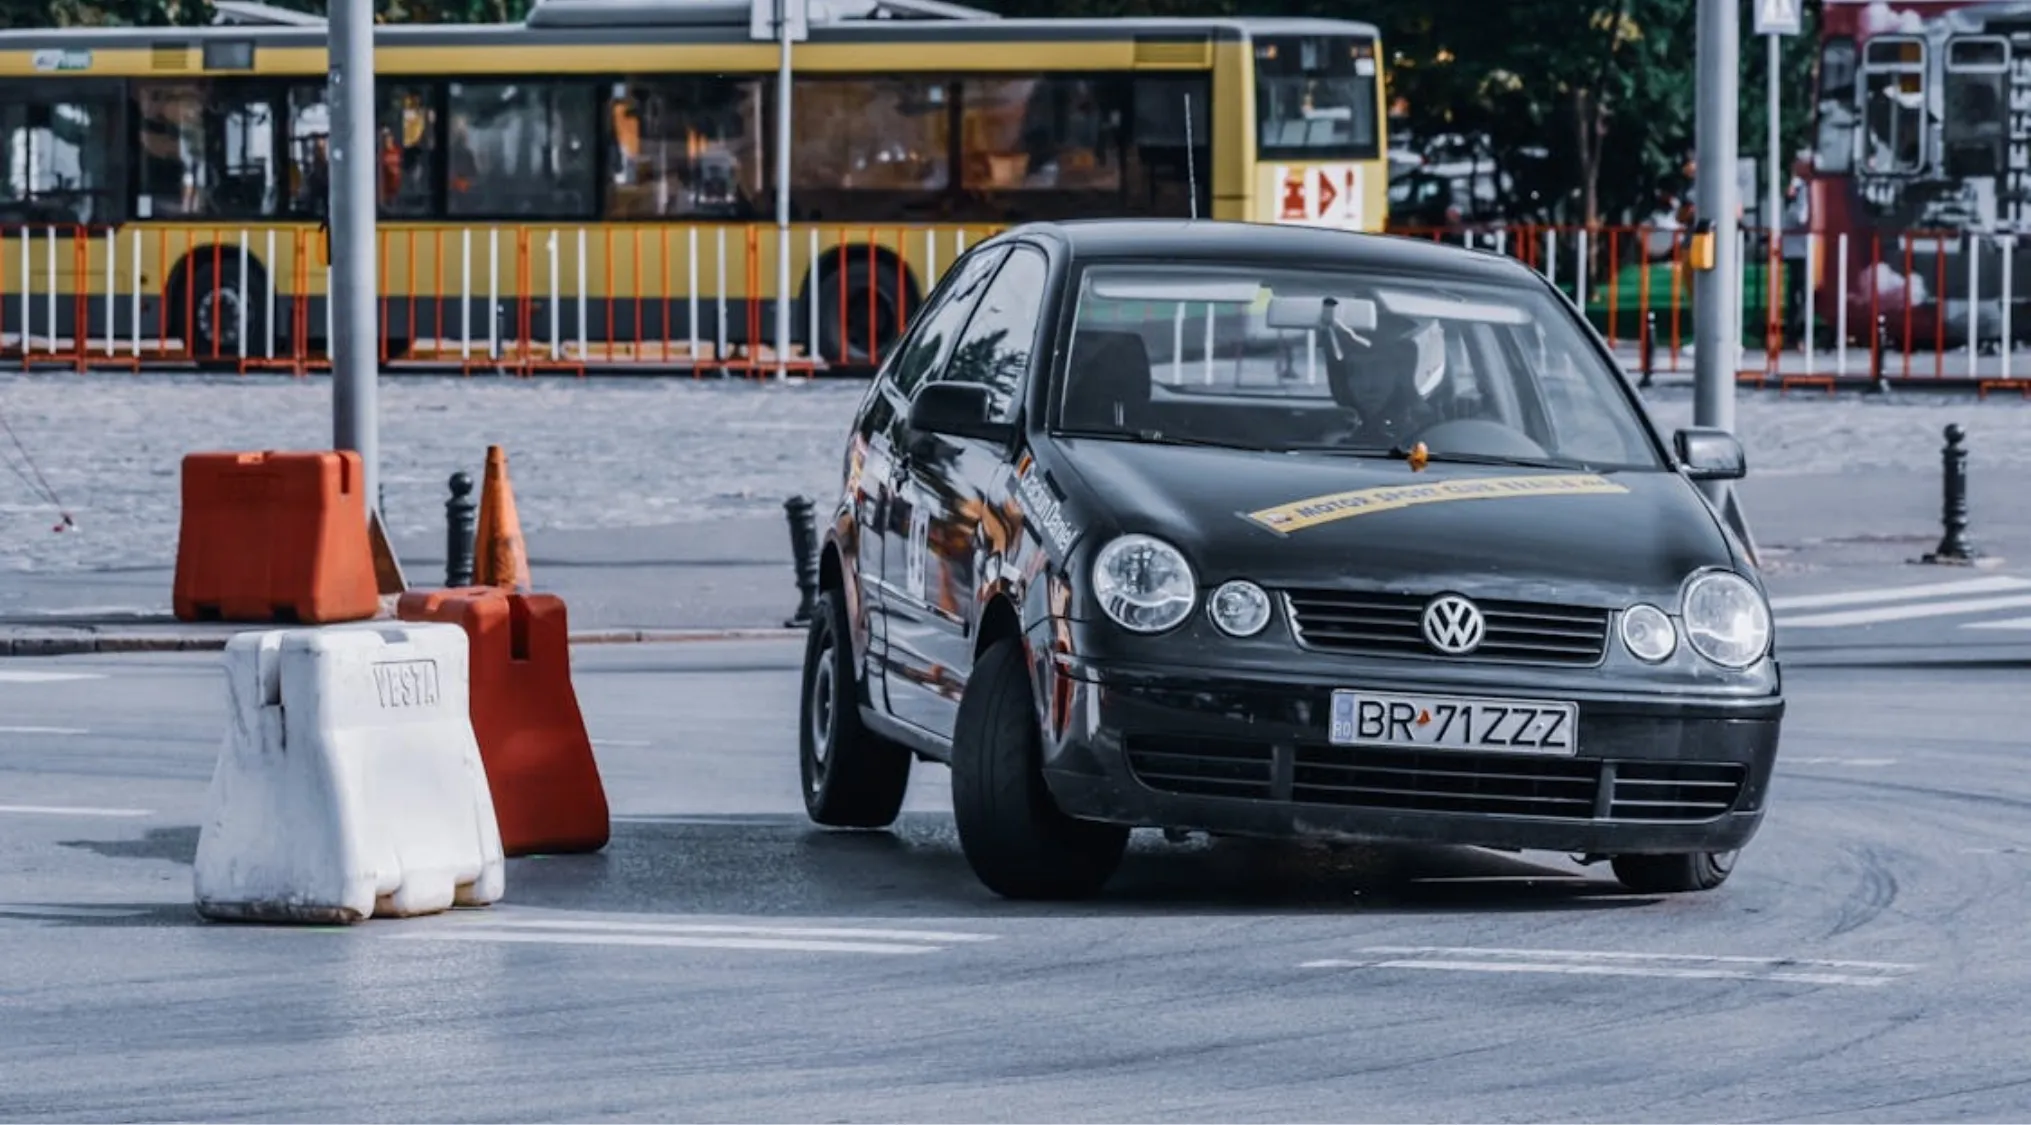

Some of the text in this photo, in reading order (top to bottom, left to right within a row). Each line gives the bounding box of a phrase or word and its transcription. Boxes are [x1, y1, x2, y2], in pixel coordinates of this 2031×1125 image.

[1295, 496, 1368, 518] MOTOR
[1423, 595, 1485, 653] VW
[1358, 701, 1417, 741] BR
